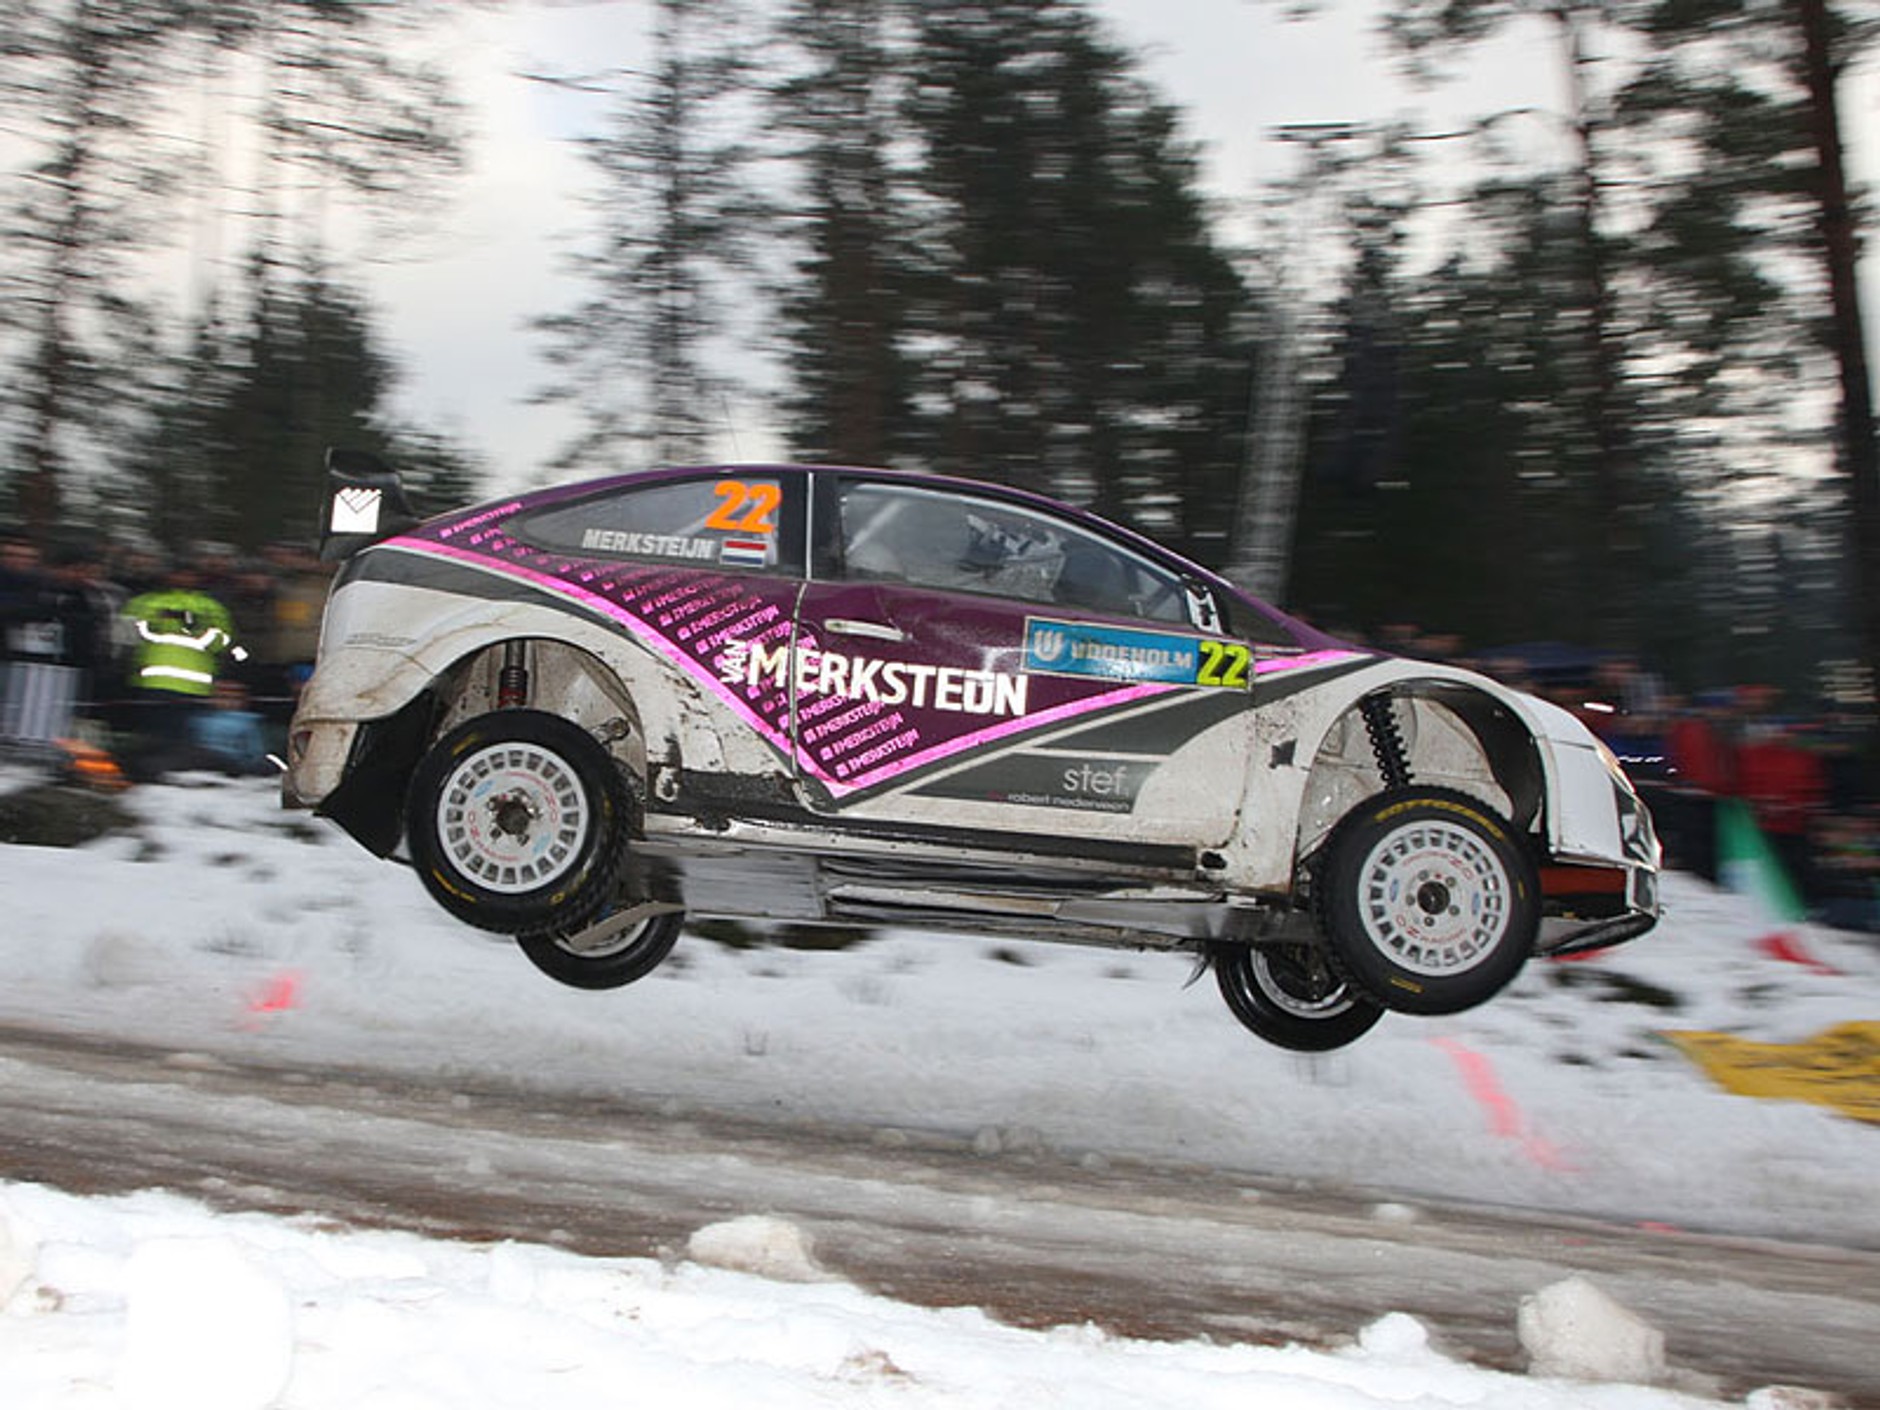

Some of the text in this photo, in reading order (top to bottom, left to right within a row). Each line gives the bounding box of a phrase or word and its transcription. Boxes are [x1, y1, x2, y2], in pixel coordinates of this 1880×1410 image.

[704, 480, 783, 533] 22
[582, 528, 716, 559] MERKSTEIJN
[719, 639, 748, 686] VAN
[745, 638, 1028, 717] MERKSTEIJN
[1196, 640, 1250, 688] 22
